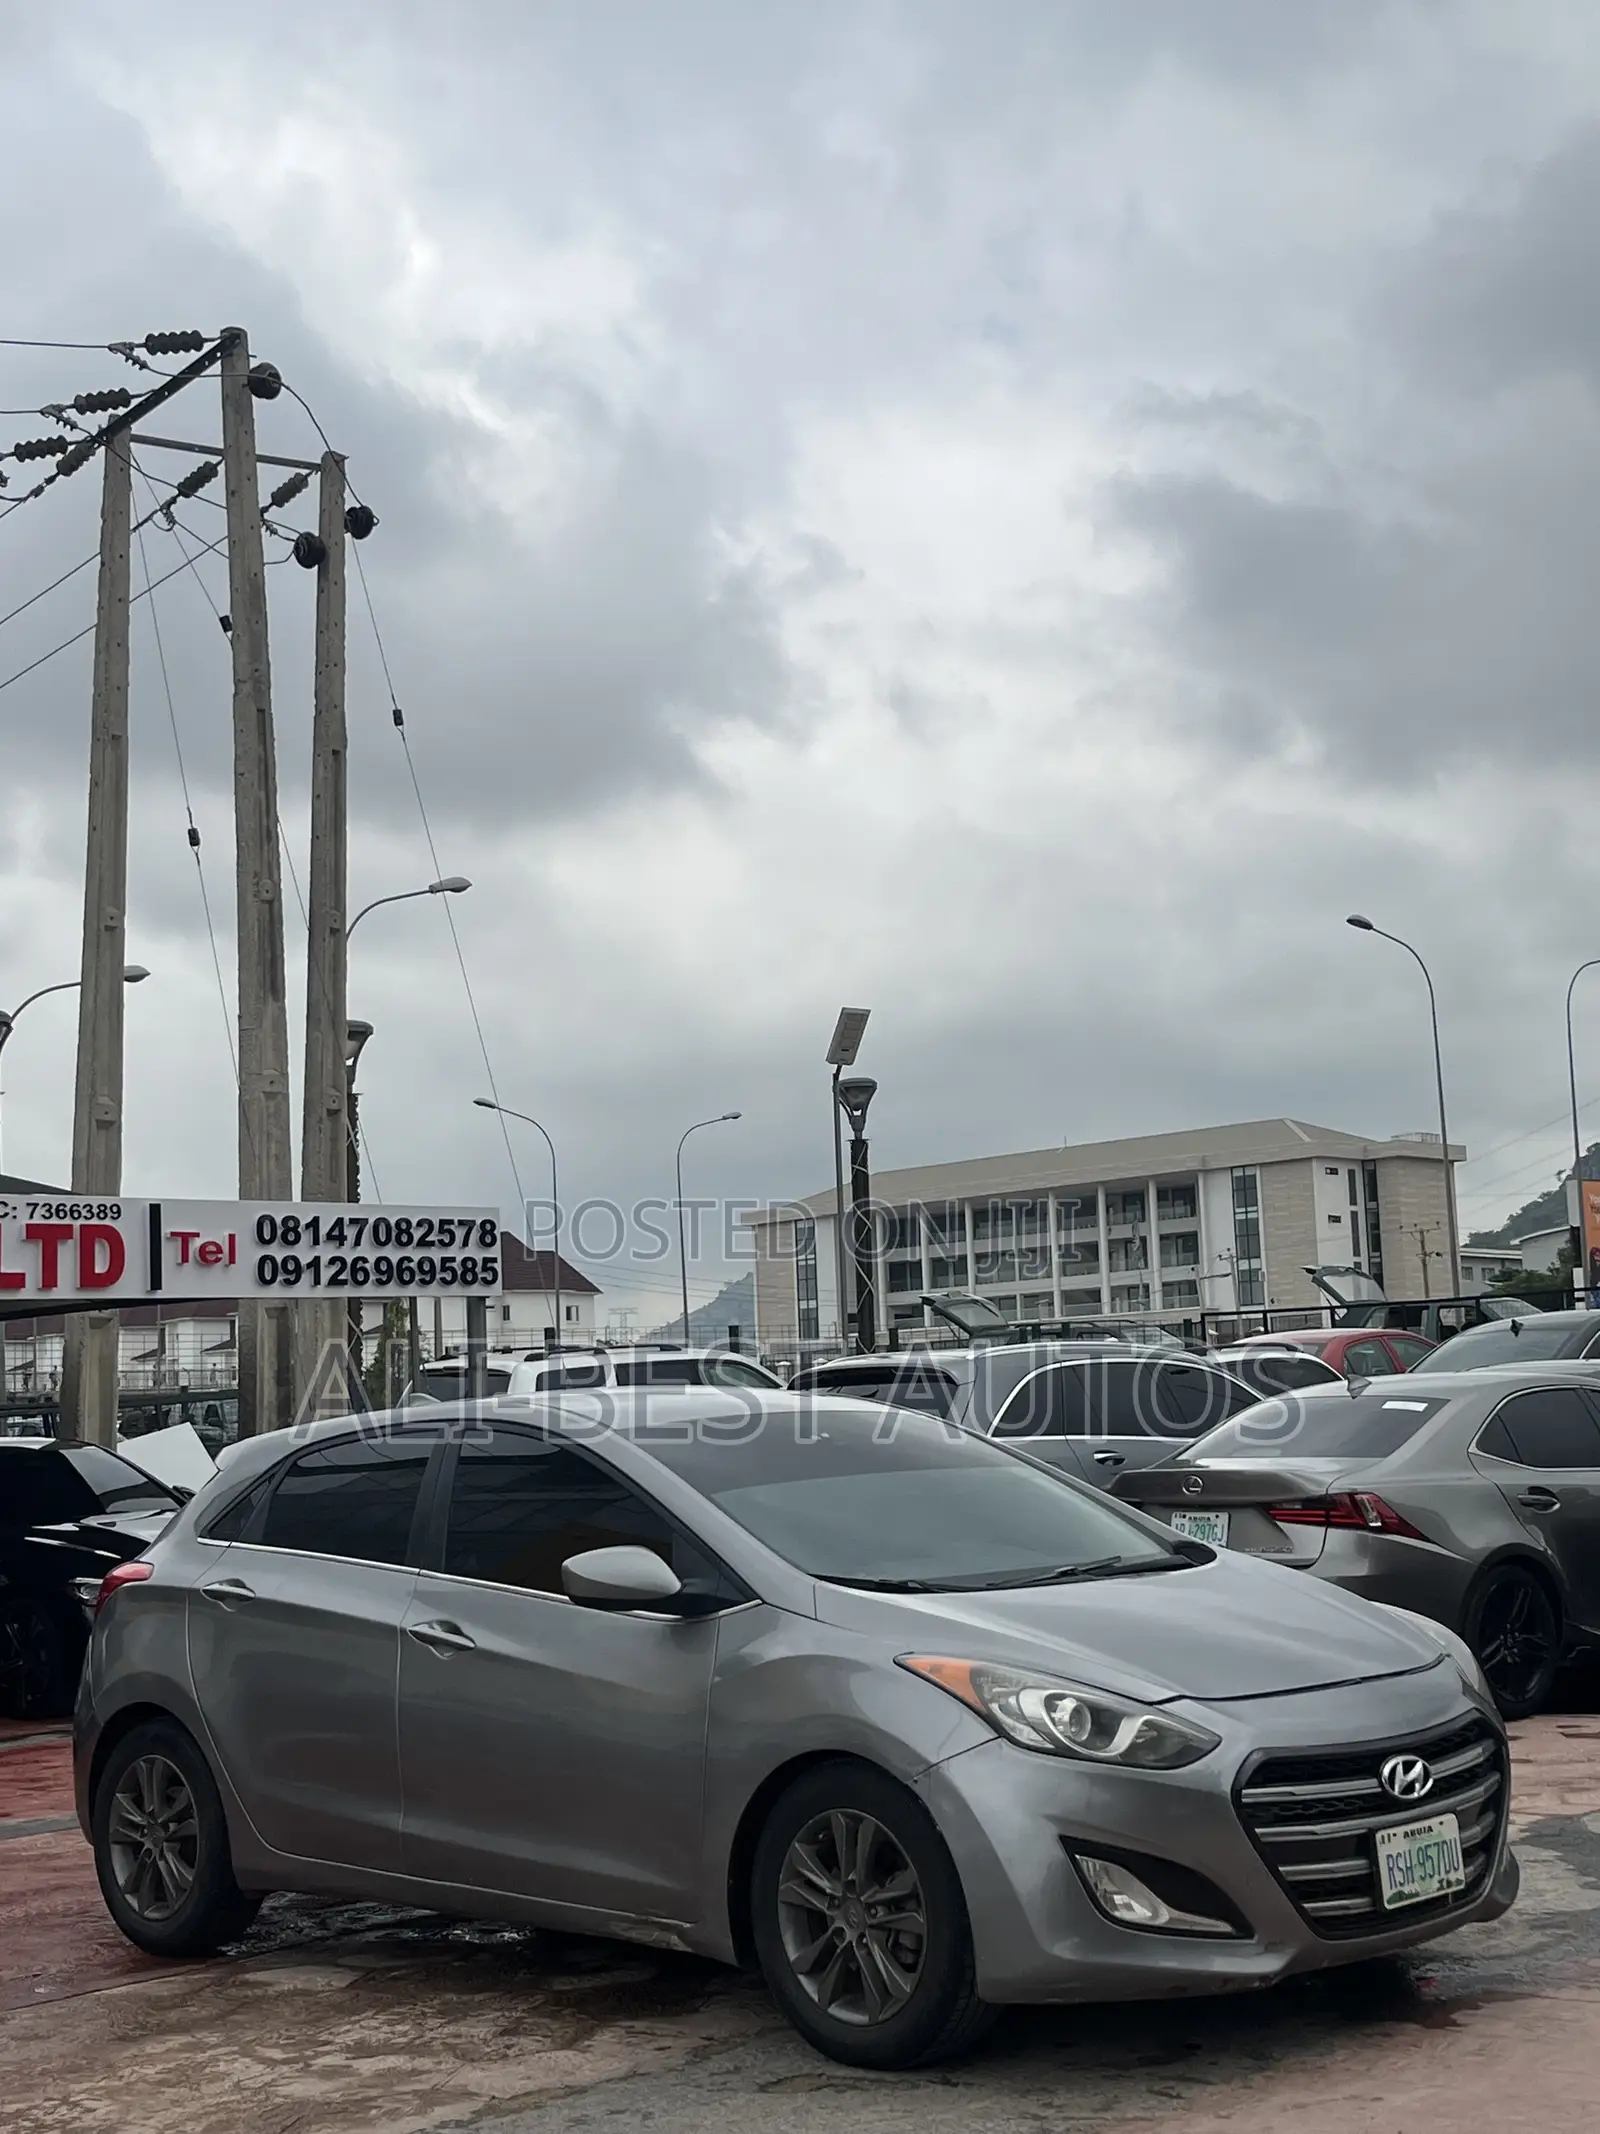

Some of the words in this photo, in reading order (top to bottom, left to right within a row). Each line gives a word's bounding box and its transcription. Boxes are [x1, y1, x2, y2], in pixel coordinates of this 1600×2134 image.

[26, 1203, 122, 1220] 7366389
[256, 1214, 497, 1248] 08147082578
[169, 1231, 236, 1265] Tel
[257, 1254, 498, 1287] 09126969585
